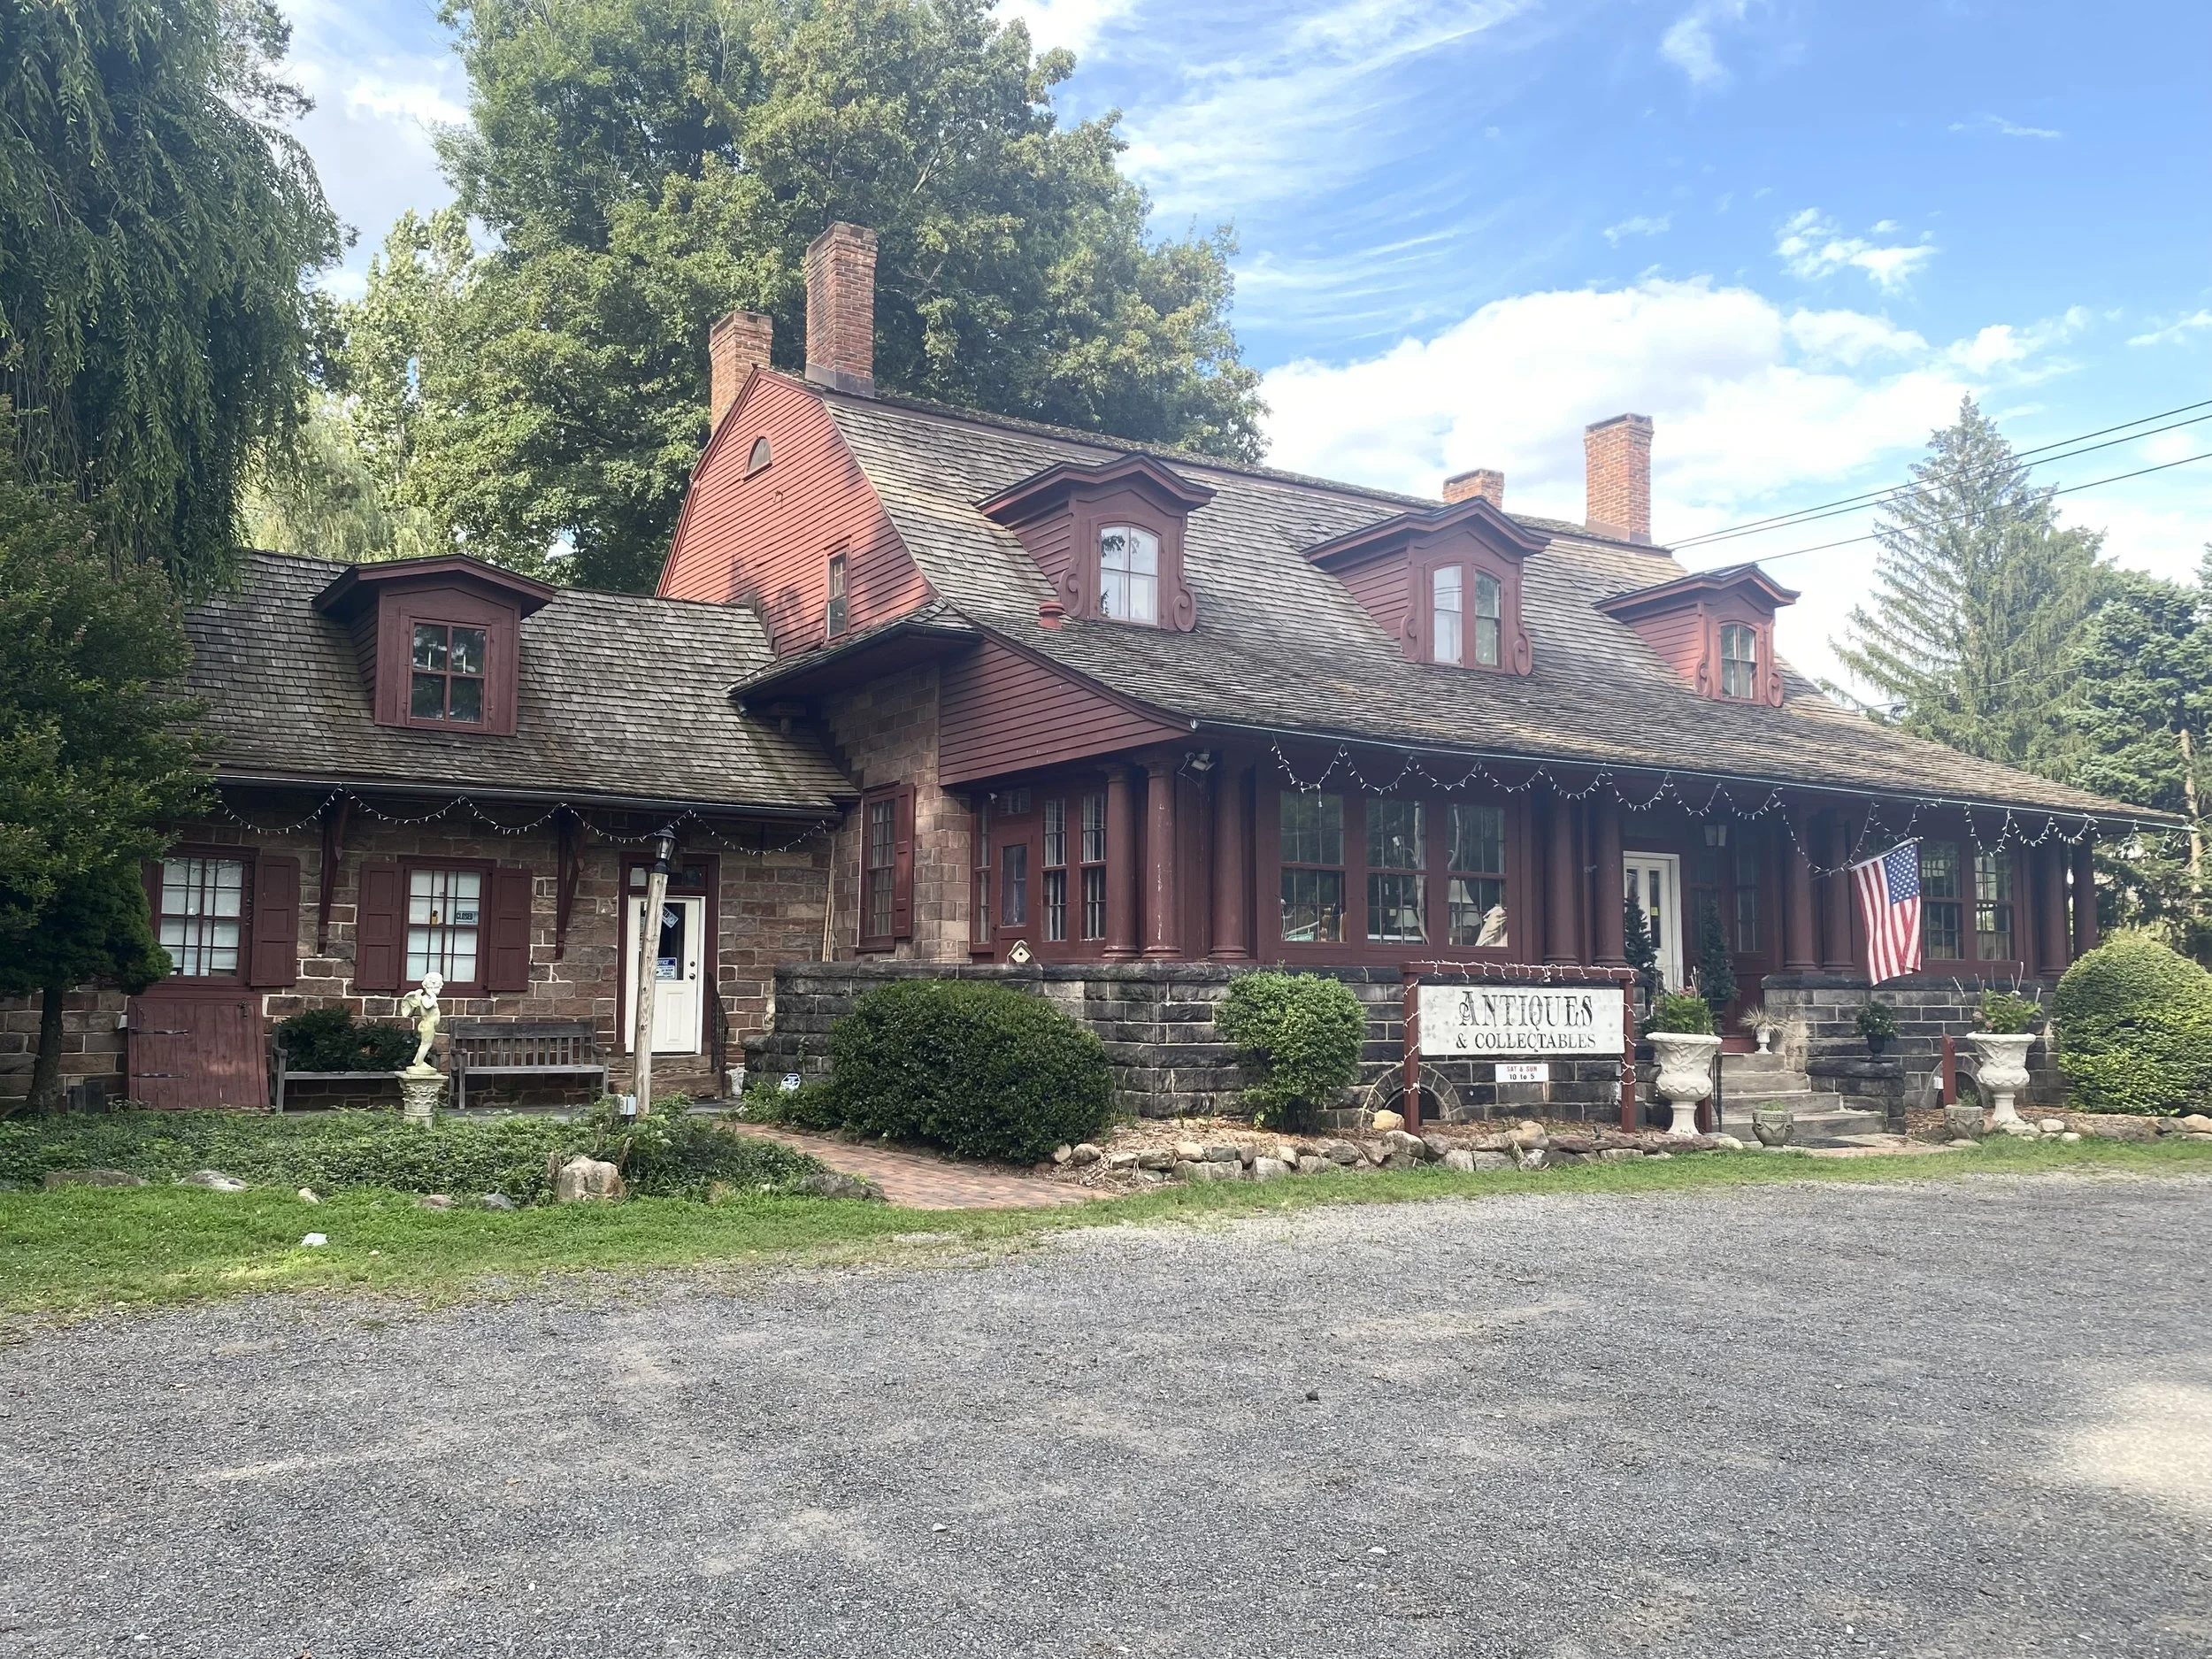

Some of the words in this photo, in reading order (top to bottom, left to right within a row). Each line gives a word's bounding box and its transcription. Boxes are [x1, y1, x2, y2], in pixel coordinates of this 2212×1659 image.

[1459, 991, 1593, 1031] ANTIQUES
[1455, 1033, 1467, 1048] &
[1475, 1033, 1596, 1049] COLLECTABLES
